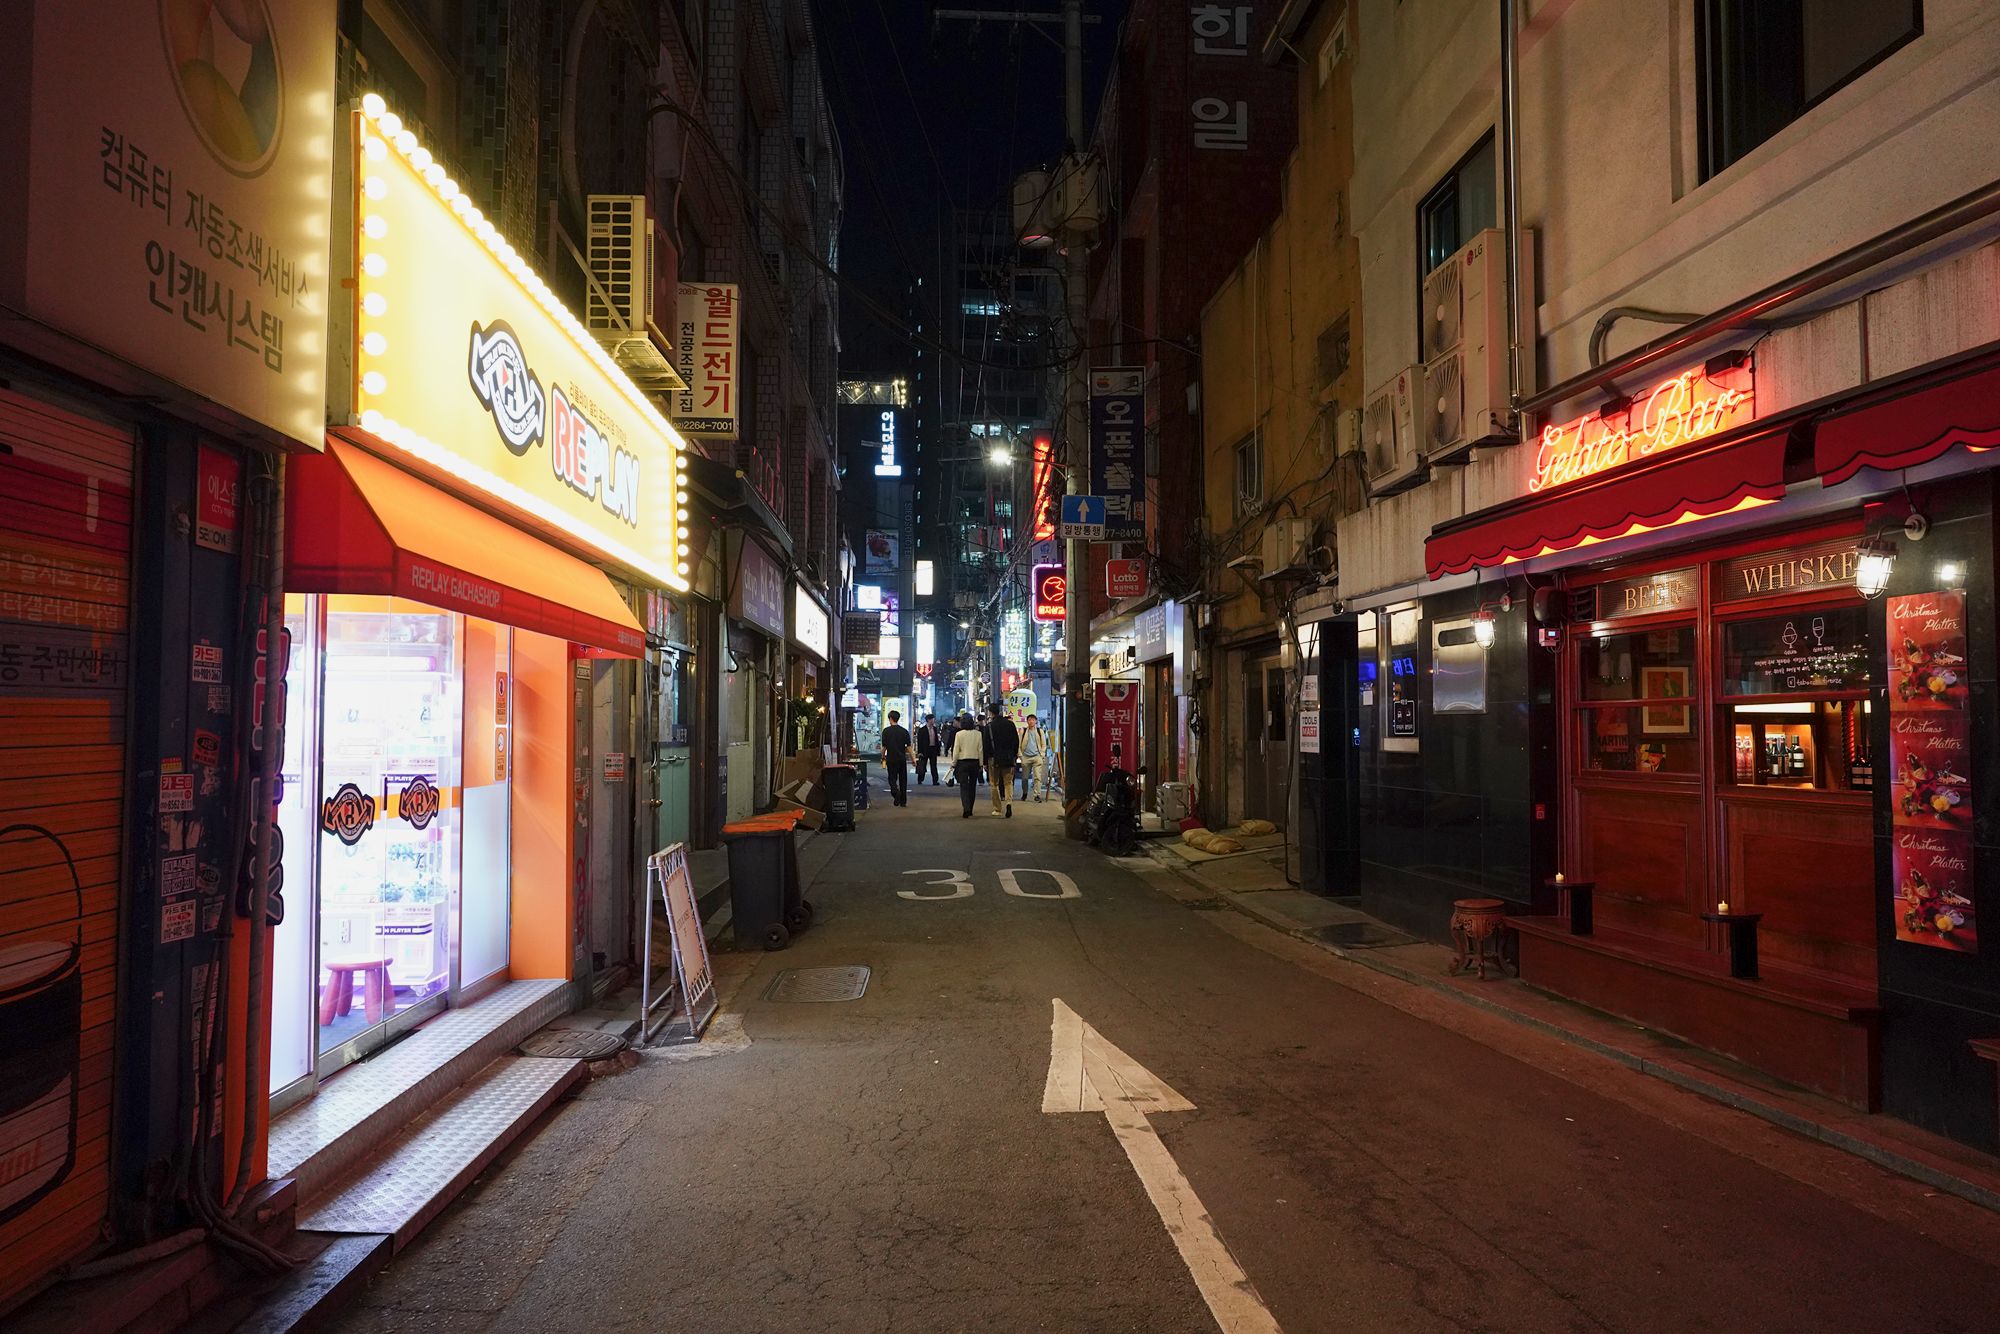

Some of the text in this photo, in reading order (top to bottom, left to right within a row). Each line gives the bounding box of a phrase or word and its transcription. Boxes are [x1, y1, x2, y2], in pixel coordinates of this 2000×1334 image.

[100, 126, 311, 311] 컴퓨터 자동조색서비스
[1474, 244, 1483, 259] LG
[144, 239, 284, 374] 인캔시스템
[702, 287, 732, 413] 월드전기
[1641, 371, 1744, 455] Bar
[552, 382, 640, 529] REPLAY
[1529, 416, 1639, 492] Gelato
[1064, 525, 1101, 537] 일방통행
[412, 565, 501, 608] REPLAY GACHASHOP
[1112, 574, 1139, 582] Lotto
[1743, 550, 1857, 594] WHISKE
[1624, 580, 1683, 611] BEER
[1893, 599, 1943, 620] Christmas
[1923, 617, 1961, 633] Platter
[30, 646, 121, 684] 주민센터
[1102, 708, 1131, 725] 복권
[1896, 717, 1945, 736] Christmas
[1926, 735, 1964, 751] Platter
[1899, 832, 1950, 852] Christmas
[1929, 853, 1968, 872] Platter
[896, 868, 1083, 901] 30
